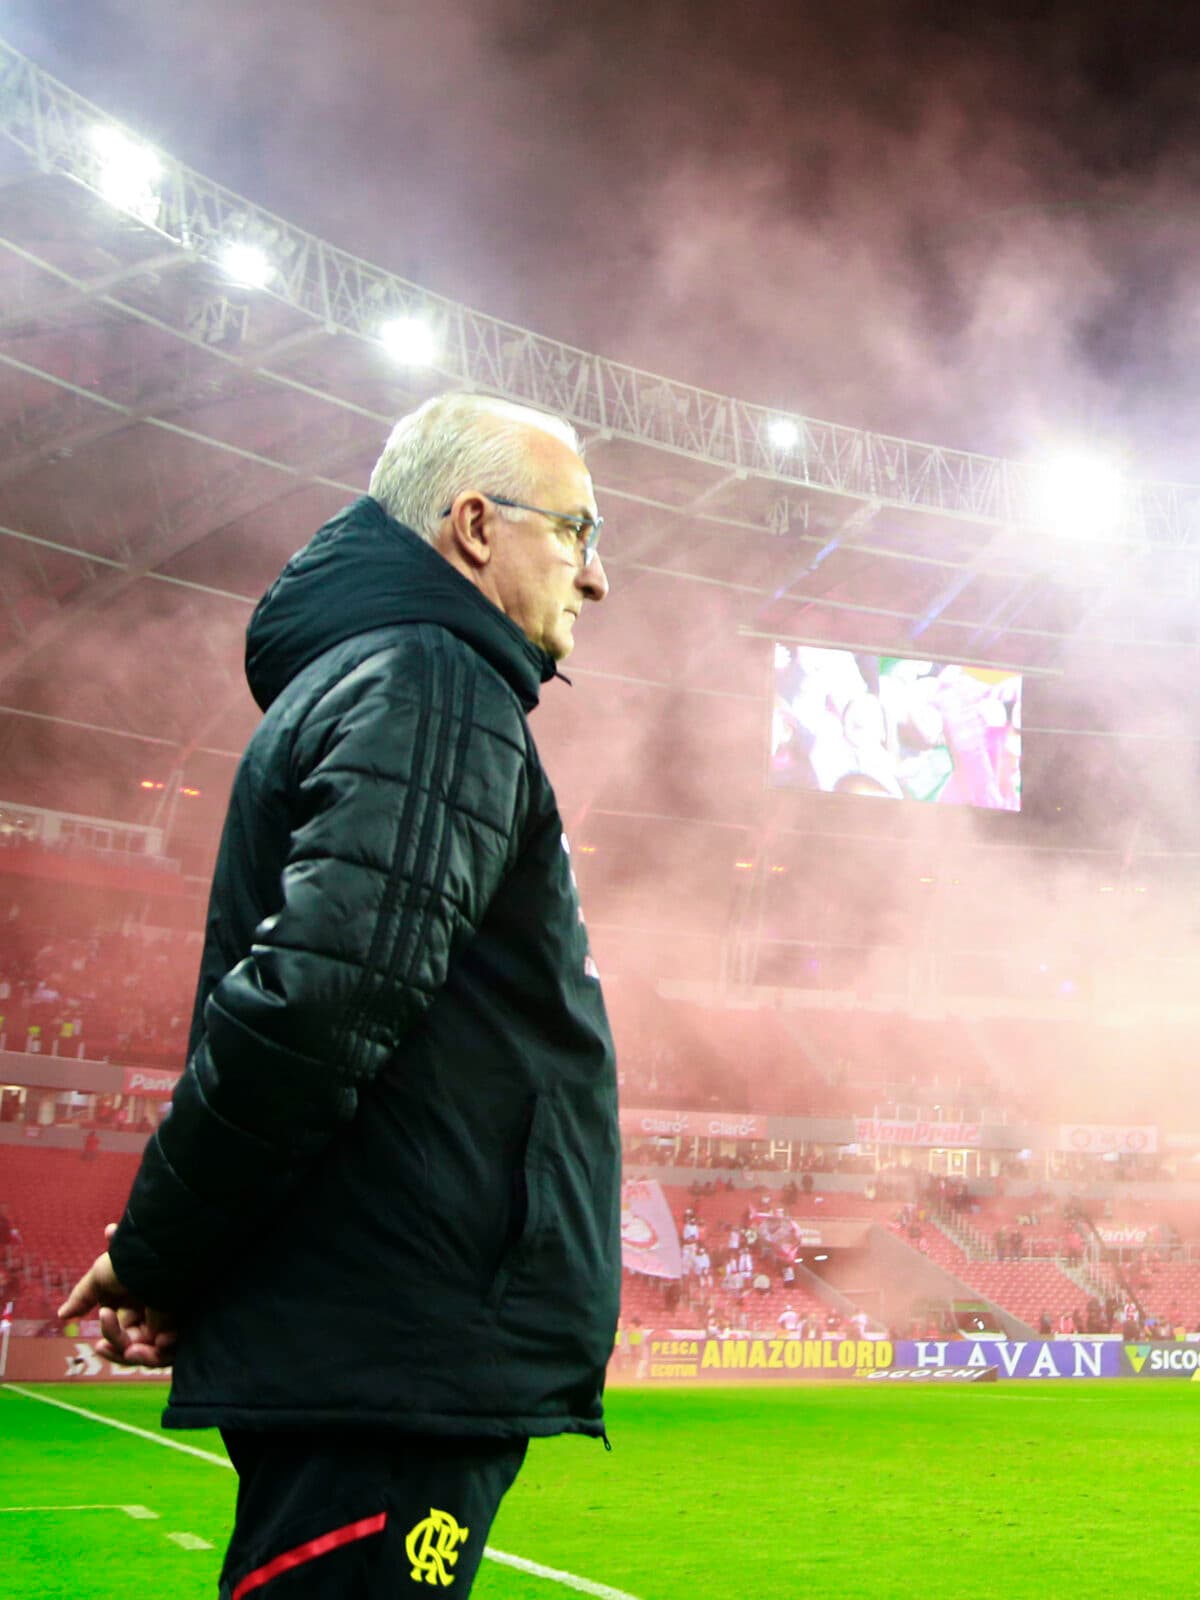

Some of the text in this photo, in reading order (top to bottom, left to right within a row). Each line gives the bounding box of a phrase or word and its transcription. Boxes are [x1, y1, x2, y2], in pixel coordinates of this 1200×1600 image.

[129, 1072, 180, 1090] Panv
[641, 1117, 682, 1134] Claro
[709, 1120, 750, 1136] Claro
[651, 1341, 699, 1355] PESCA
[701, 1340, 894, 1369] AMAZONLORD
[914, 1342, 1105, 1377] HAVAN
